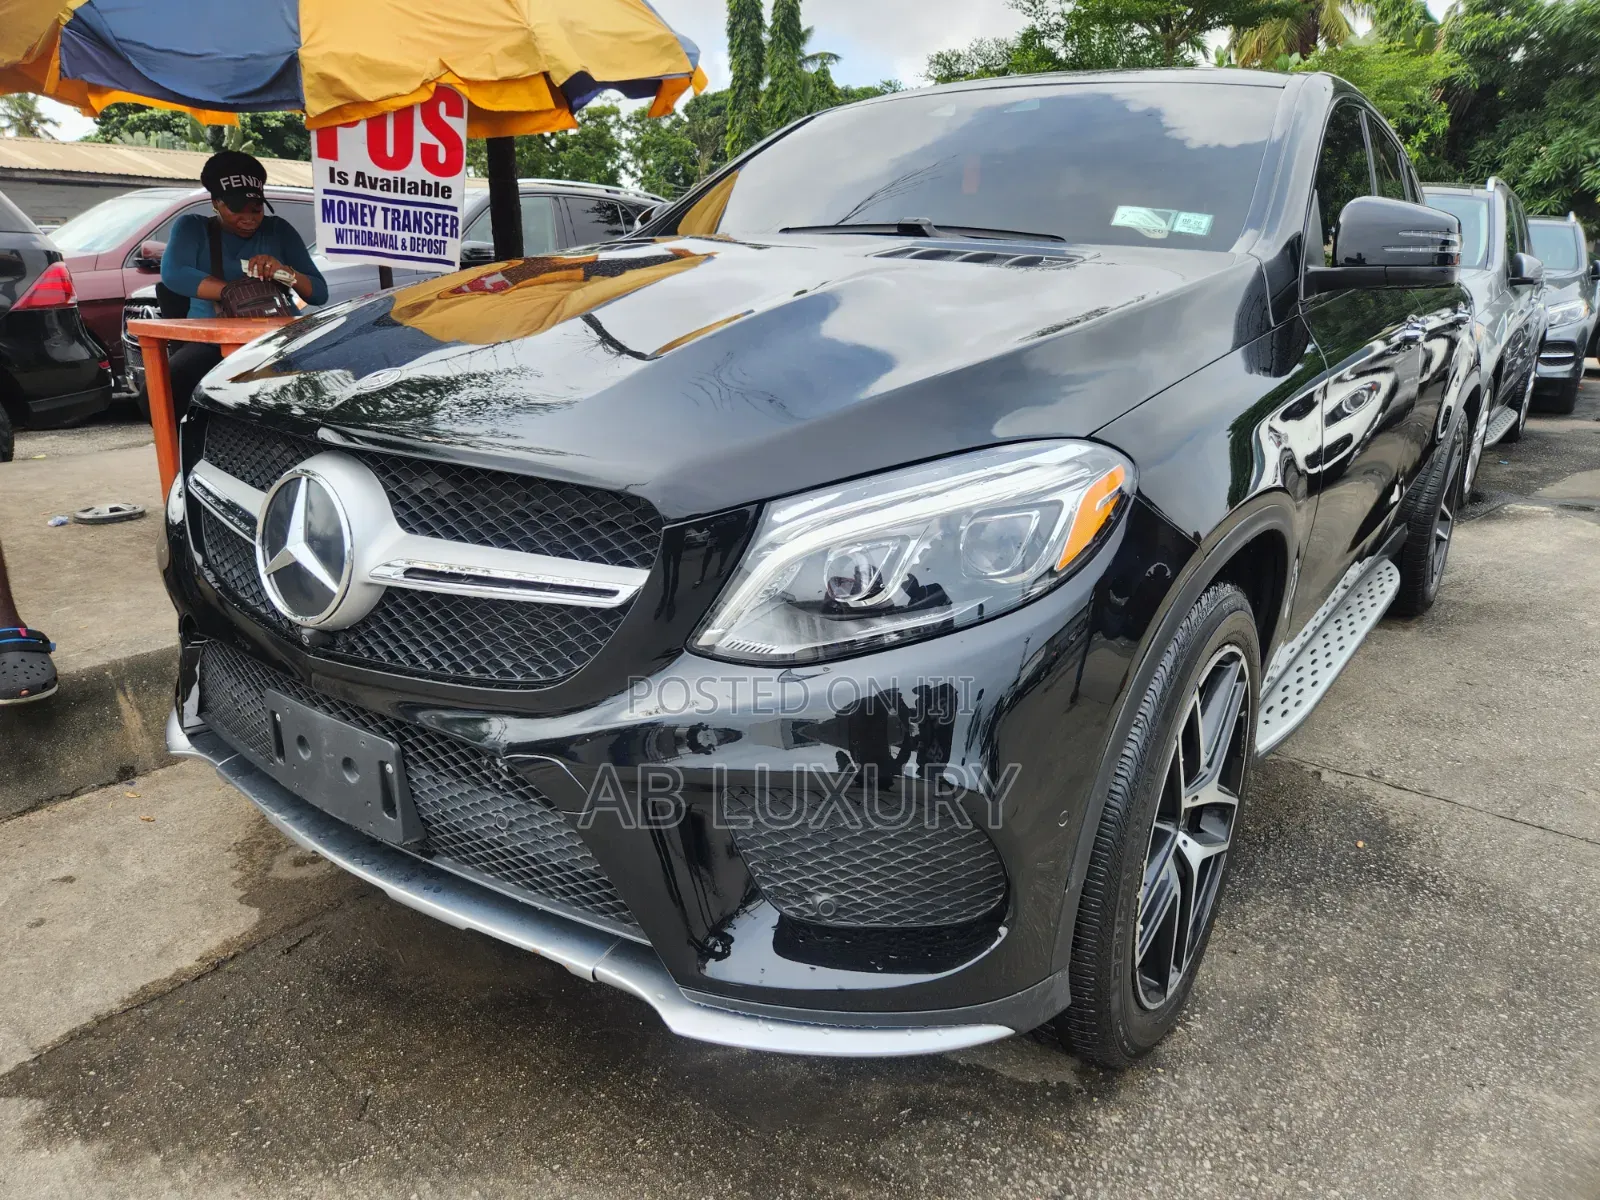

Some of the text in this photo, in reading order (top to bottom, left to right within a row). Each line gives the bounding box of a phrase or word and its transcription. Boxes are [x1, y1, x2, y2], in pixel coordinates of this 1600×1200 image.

[329, 167, 452, 200] Is Available
[321, 198, 459, 239] MONEY TRANSFER
[335, 227, 448, 256] WITHDRAWAL & DEPOSIT
